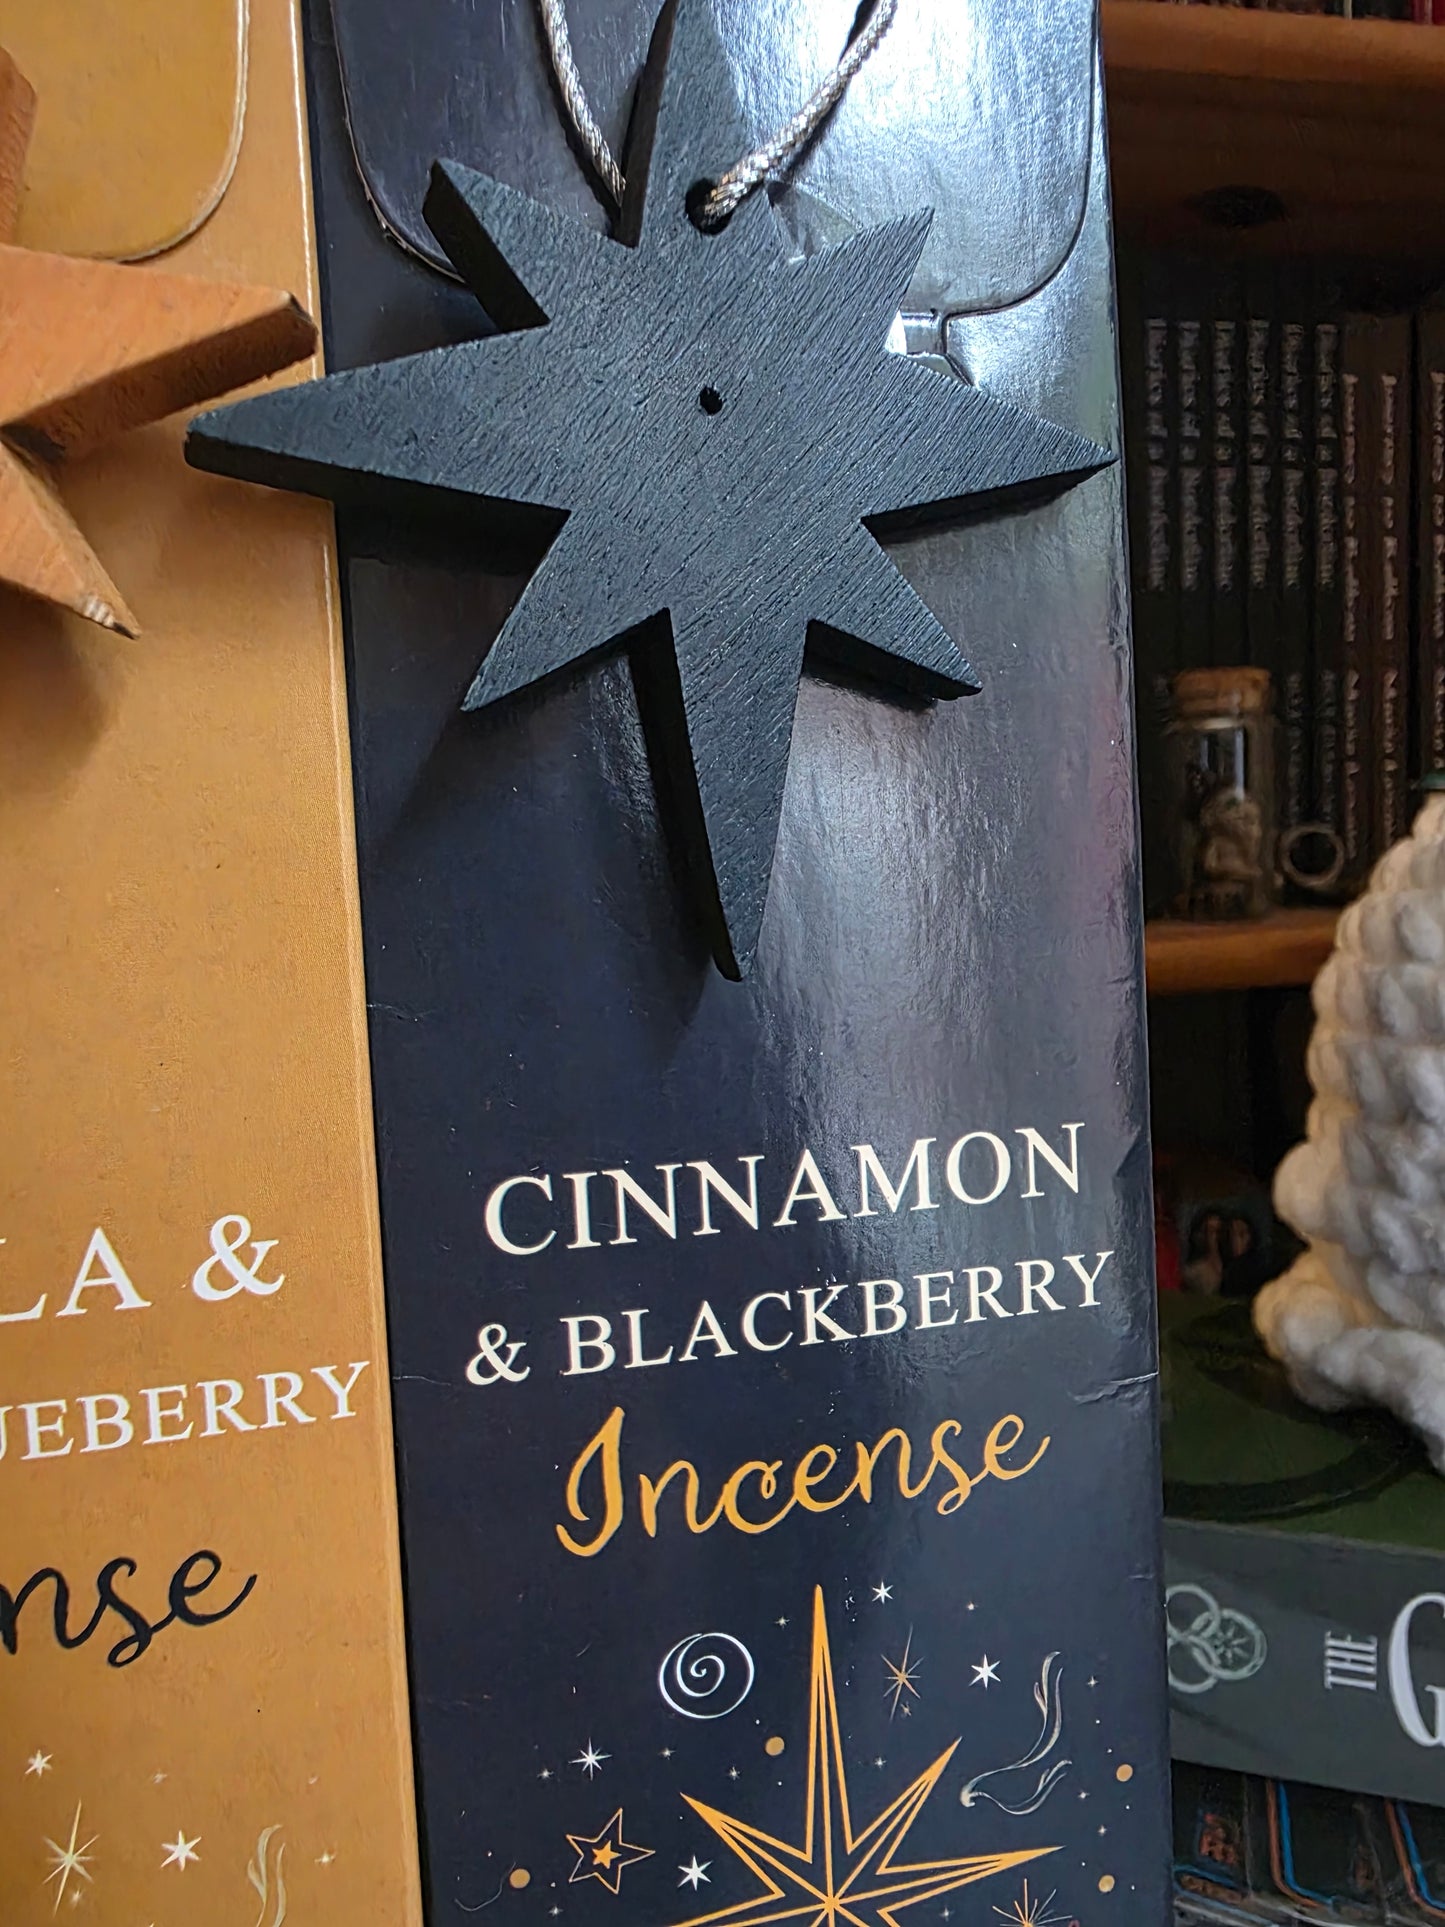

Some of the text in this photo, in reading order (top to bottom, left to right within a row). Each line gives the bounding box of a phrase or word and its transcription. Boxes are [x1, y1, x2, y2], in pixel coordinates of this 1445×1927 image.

[484, 1122, 1086, 1255] CINNAMON
[191, 1214, 285, 1302] &
[465, 1250, 1115, 1386] & BLACKBERRY
[0, 1360, 370, 1460] EBERRY
[555, 1406, 1051, 1558] Incense
[1323, 1629, 1379, 1691] THE
